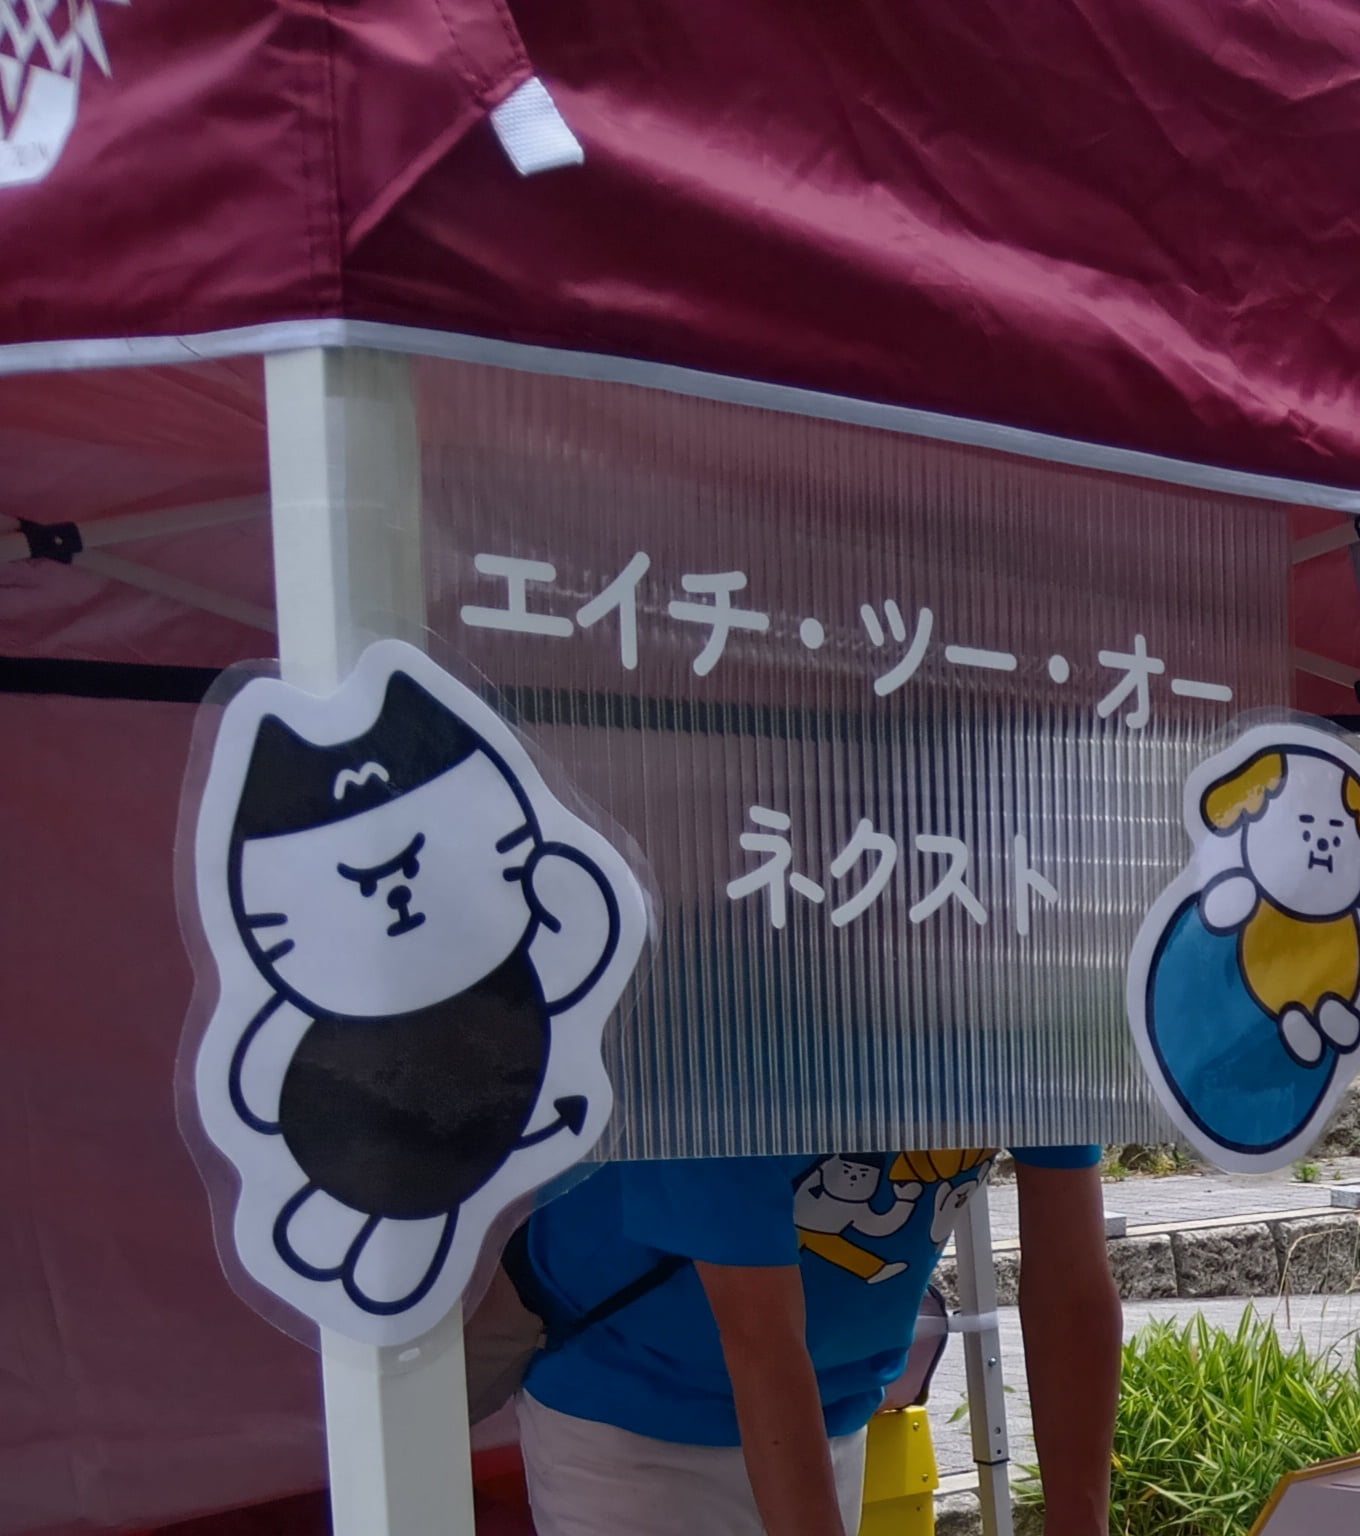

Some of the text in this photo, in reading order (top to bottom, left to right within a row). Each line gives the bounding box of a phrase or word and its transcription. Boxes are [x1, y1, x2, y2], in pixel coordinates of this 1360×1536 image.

[460, 549, 1233, 731] エイチ・ツー・オー
[725, 803, 1058, 937] ネクスト
